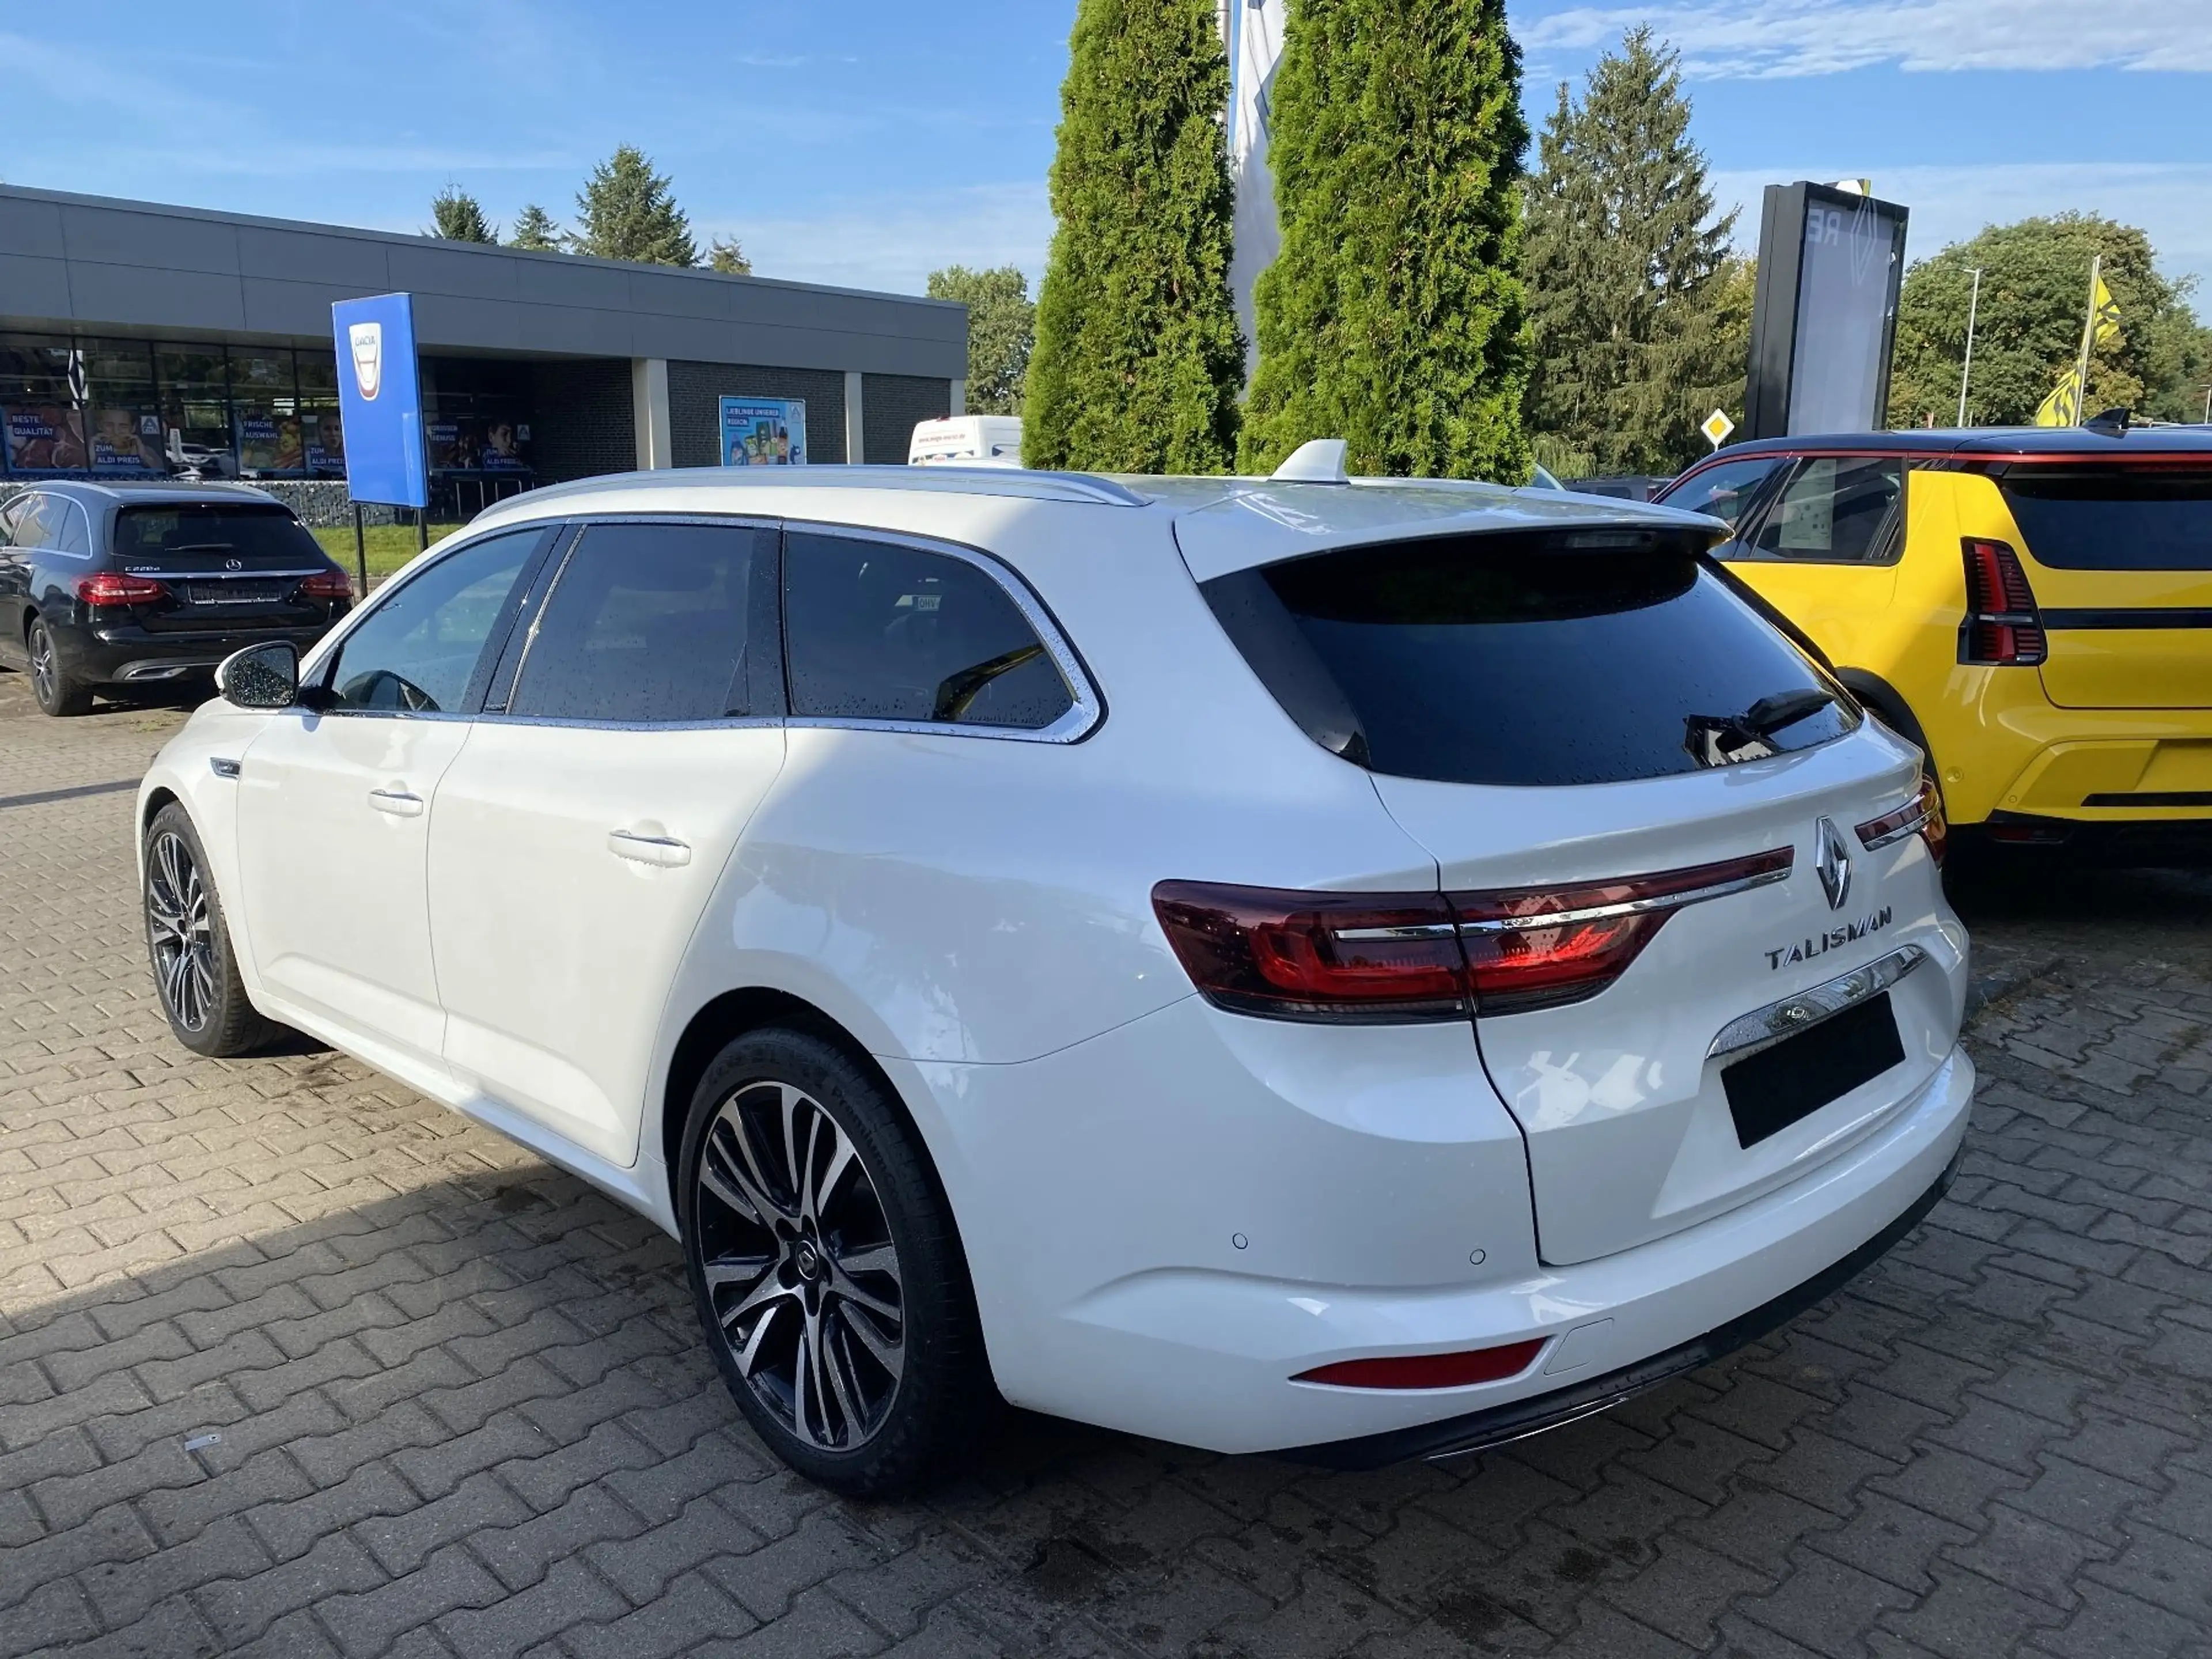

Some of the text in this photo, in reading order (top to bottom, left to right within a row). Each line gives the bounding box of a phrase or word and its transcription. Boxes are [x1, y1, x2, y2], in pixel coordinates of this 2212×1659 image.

[12, 415, 40, 423] BESTE
[95, 444, 113, 452] ZUM
[116, 456, 140, 464] PREIS
[1764, 905, 1892, 971] TALISMAN
